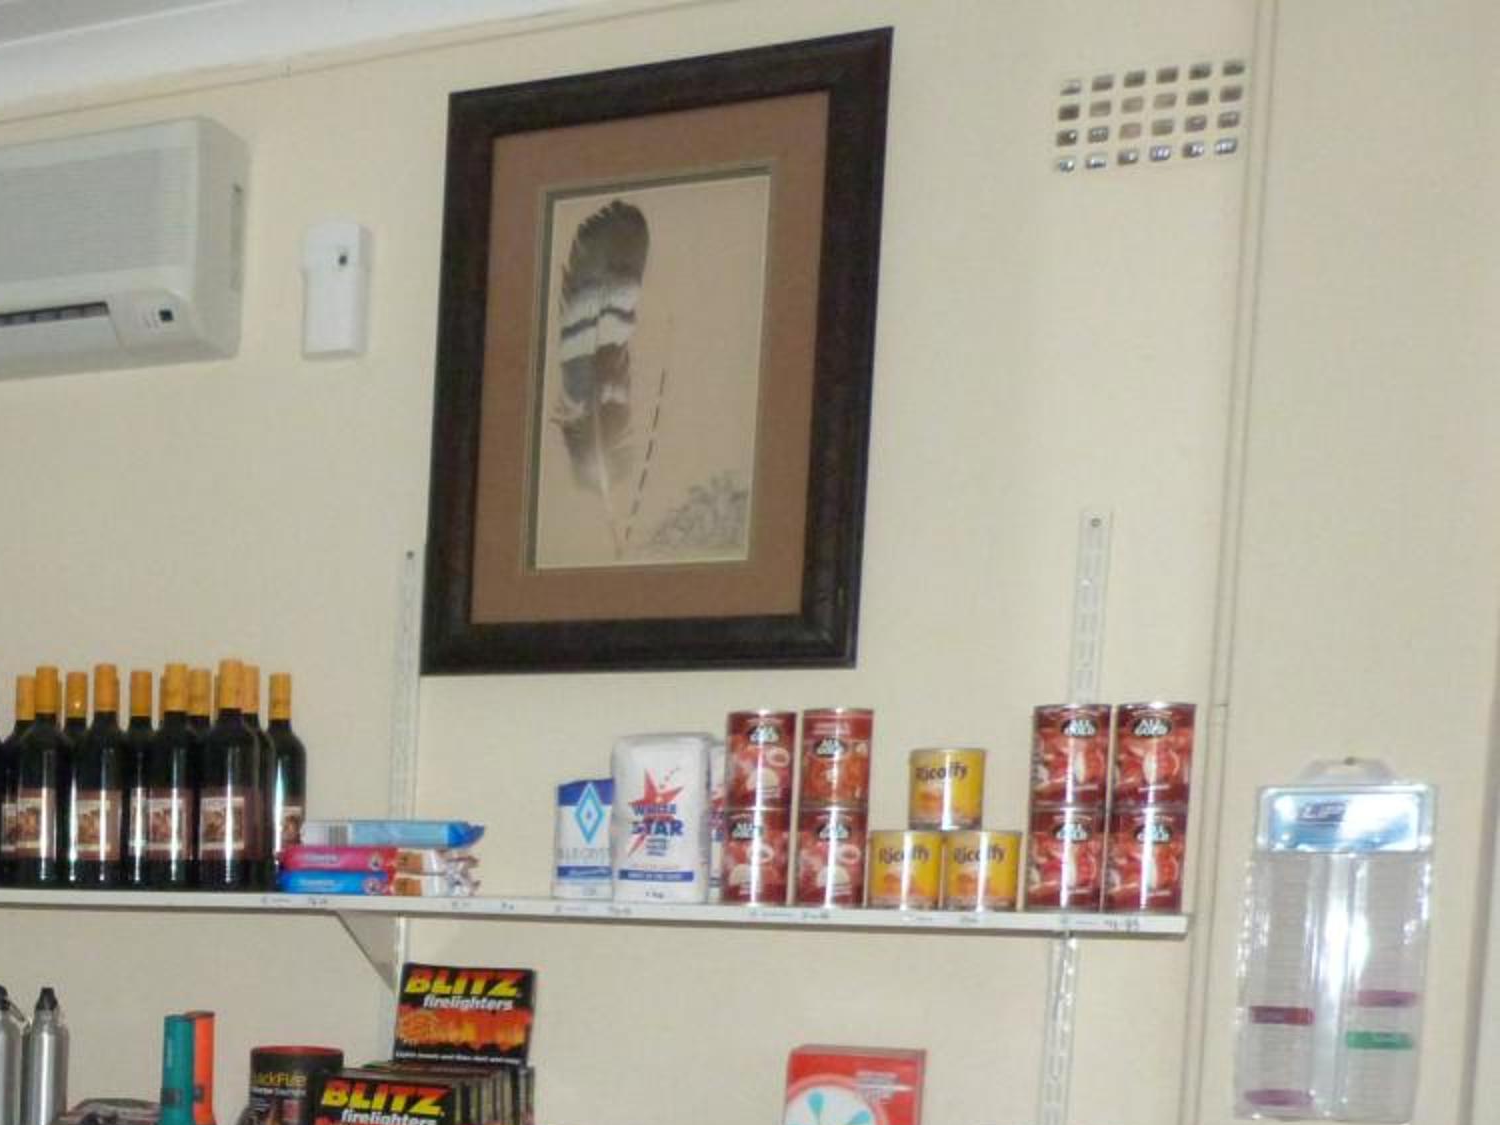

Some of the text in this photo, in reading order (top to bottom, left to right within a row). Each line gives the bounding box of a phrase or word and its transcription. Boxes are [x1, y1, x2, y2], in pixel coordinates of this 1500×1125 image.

[631, 819, 684, 836] STAR
[879, 845, 931, 864] Ricffy
[404, 967, 526, 997] BLITZ
[422, 994, 516, 1011] firelighters
[321, 1080, 449, 1116] BLITZ
